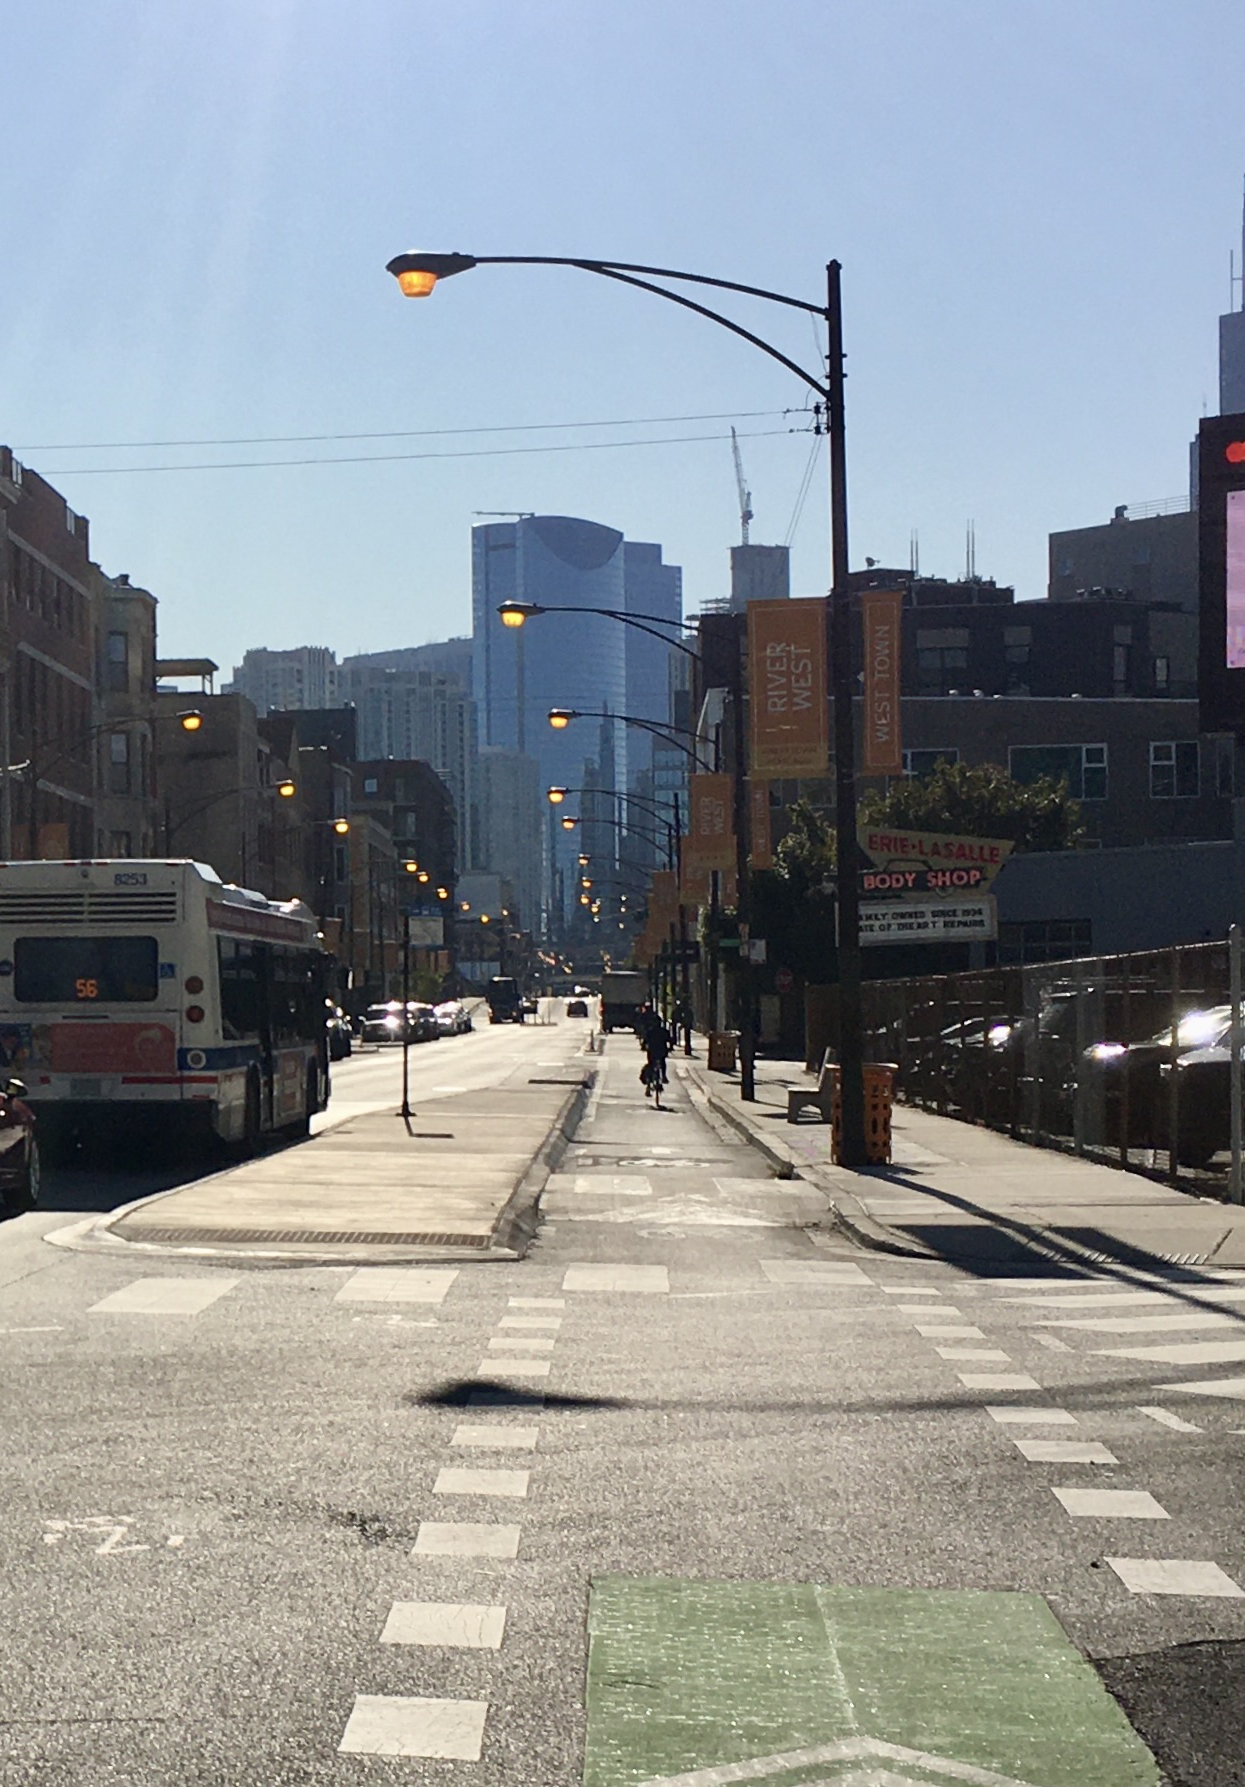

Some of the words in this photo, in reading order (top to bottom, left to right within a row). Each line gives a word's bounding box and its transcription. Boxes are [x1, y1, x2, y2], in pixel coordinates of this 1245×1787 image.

[874, 625, 891, 681] TOWN
[765, 641, 788, 714] RIVER
[789, 643, 813, 712] WEST
[874, 691, 891, 744] WEST
[114, 872, 148, 886] 8253
[862, 871, 917, 891] BODY
[925, 869, 982, 888] SHOP
[891, 911, 926, 920] OWNED
[930, 908, 960, 918] SINCE
[858, 924, 875, 933] ATE
[878, 922, 892, 932] OF
[896, 922, 914, 931] THE
[915, 920, 937, 930] ART
[943, 919, 986, 929] REPAIRS
[75, 978, 98, 998] 56
